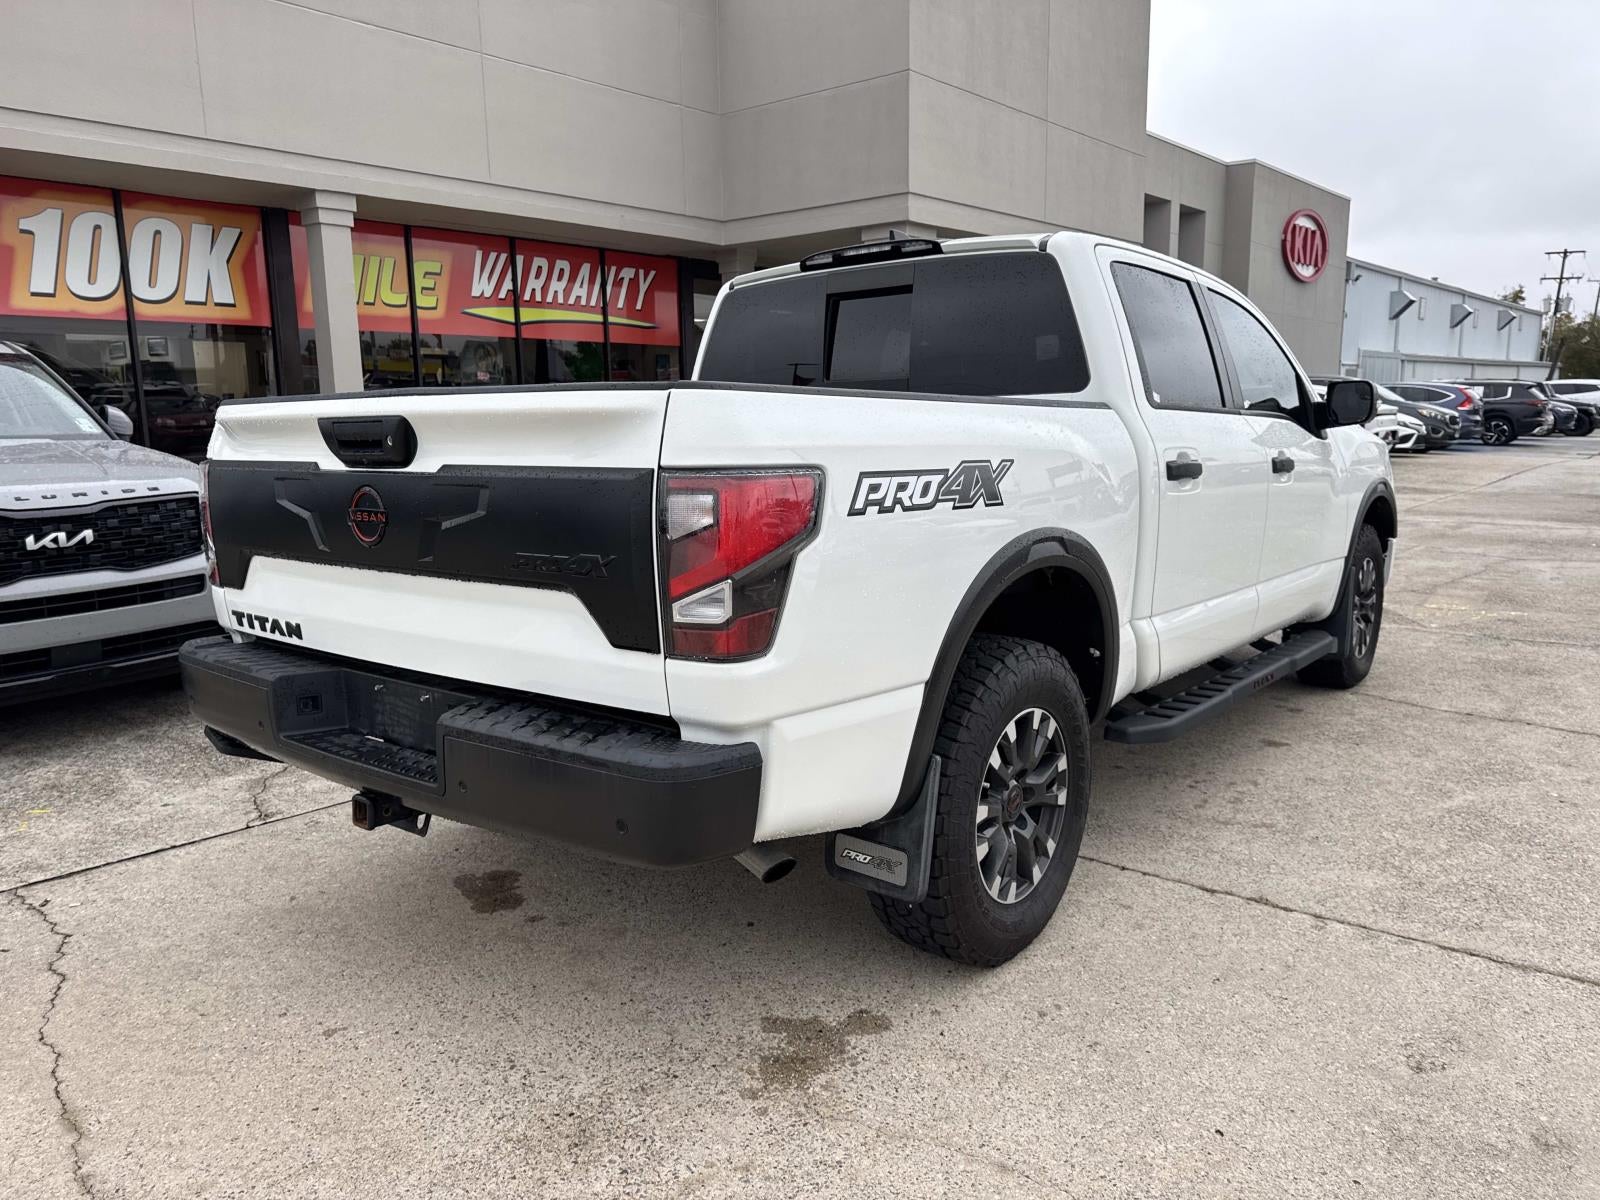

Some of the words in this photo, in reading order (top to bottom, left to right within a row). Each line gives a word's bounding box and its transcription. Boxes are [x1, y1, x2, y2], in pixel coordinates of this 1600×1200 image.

[18, 208, 242, 307] 100K
[353, 254, 442, 310] ILE
[471, 250, 656, 311] WARRANTY
[1293, 224, 1322, 268] KIA
[231, 610, 303, 640] TITAN
